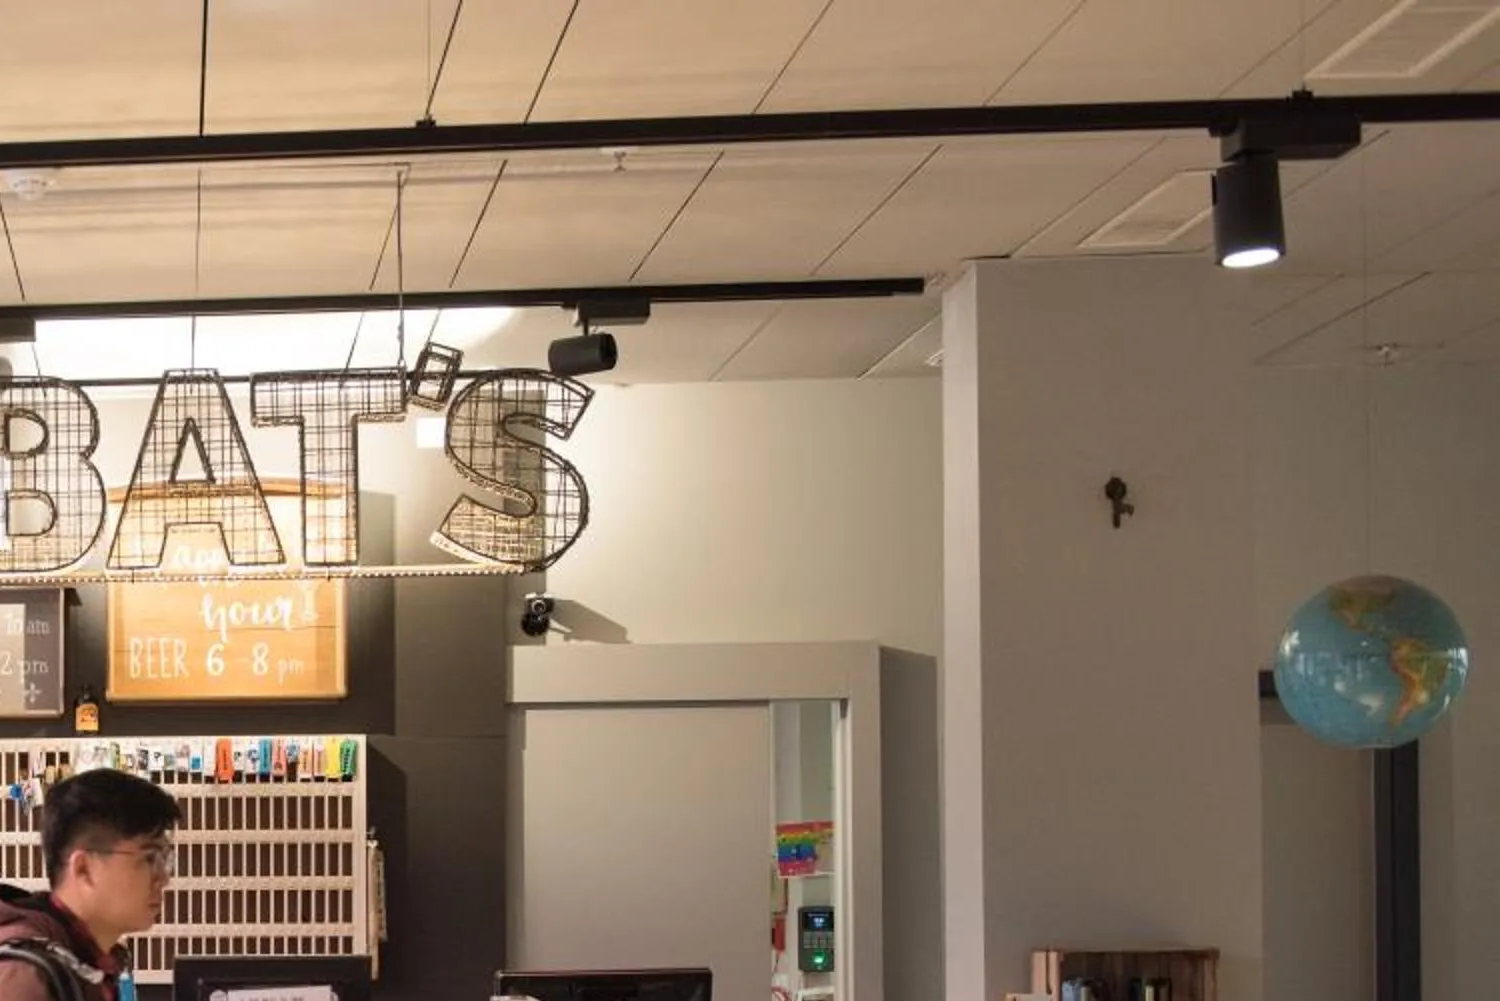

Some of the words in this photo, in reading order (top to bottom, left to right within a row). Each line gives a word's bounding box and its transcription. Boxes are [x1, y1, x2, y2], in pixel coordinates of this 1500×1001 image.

[129, 636, 191, 681] BEER
[206, 643, 226, 678] 6
[252, 642, 270, 678] 8
[277, 655, 306, 686] pm
